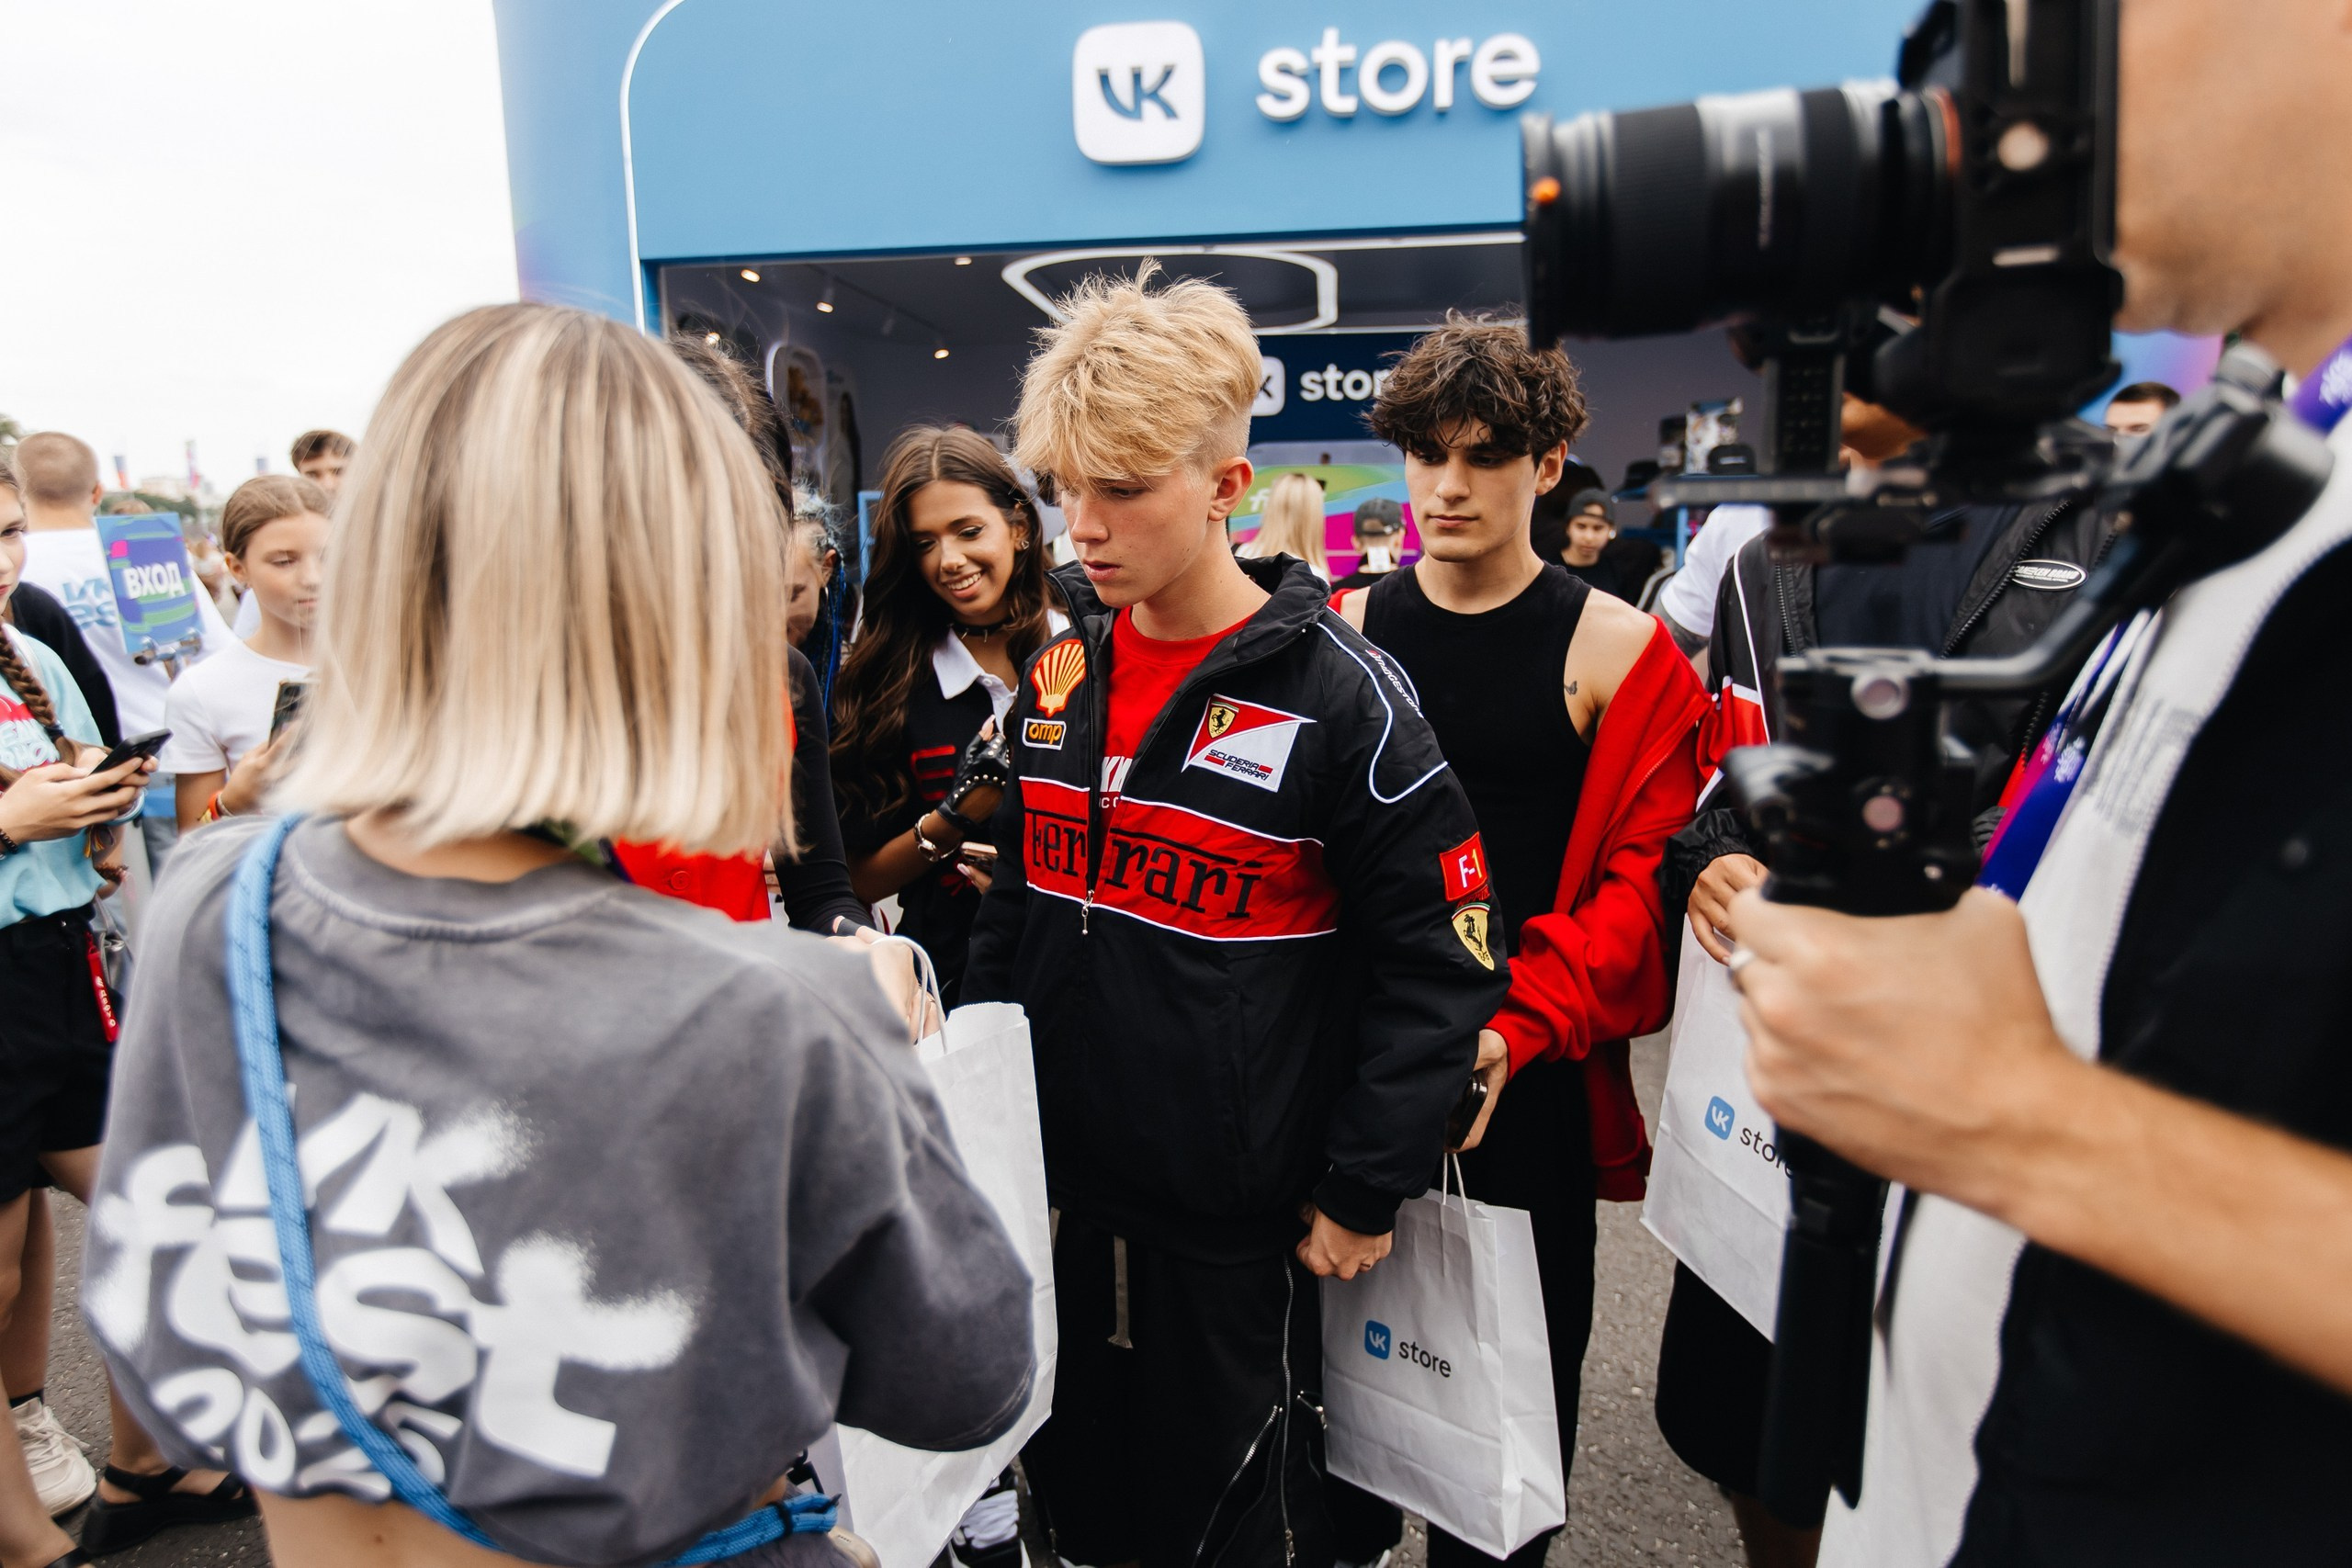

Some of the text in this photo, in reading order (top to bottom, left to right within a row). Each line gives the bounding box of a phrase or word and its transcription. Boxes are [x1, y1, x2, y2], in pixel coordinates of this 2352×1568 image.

[1096, 26, 1542, 121] VK store
[1300, 363, 1391, 401] stor
[122, 561, 185, 599] ВХОД
[1029, 723, 1062, 745] omp
[1208, 749, 1260, 770] SCUDERIA
[1225, 762, 1269, 781] FERRARI
[1025, 807, 1263, 919] Ferrari
[1458, 848, 1483, 888] F-1
[1711, 1105, 1730, 1133] VK
[1398, 1341, 1452, 1378] store
